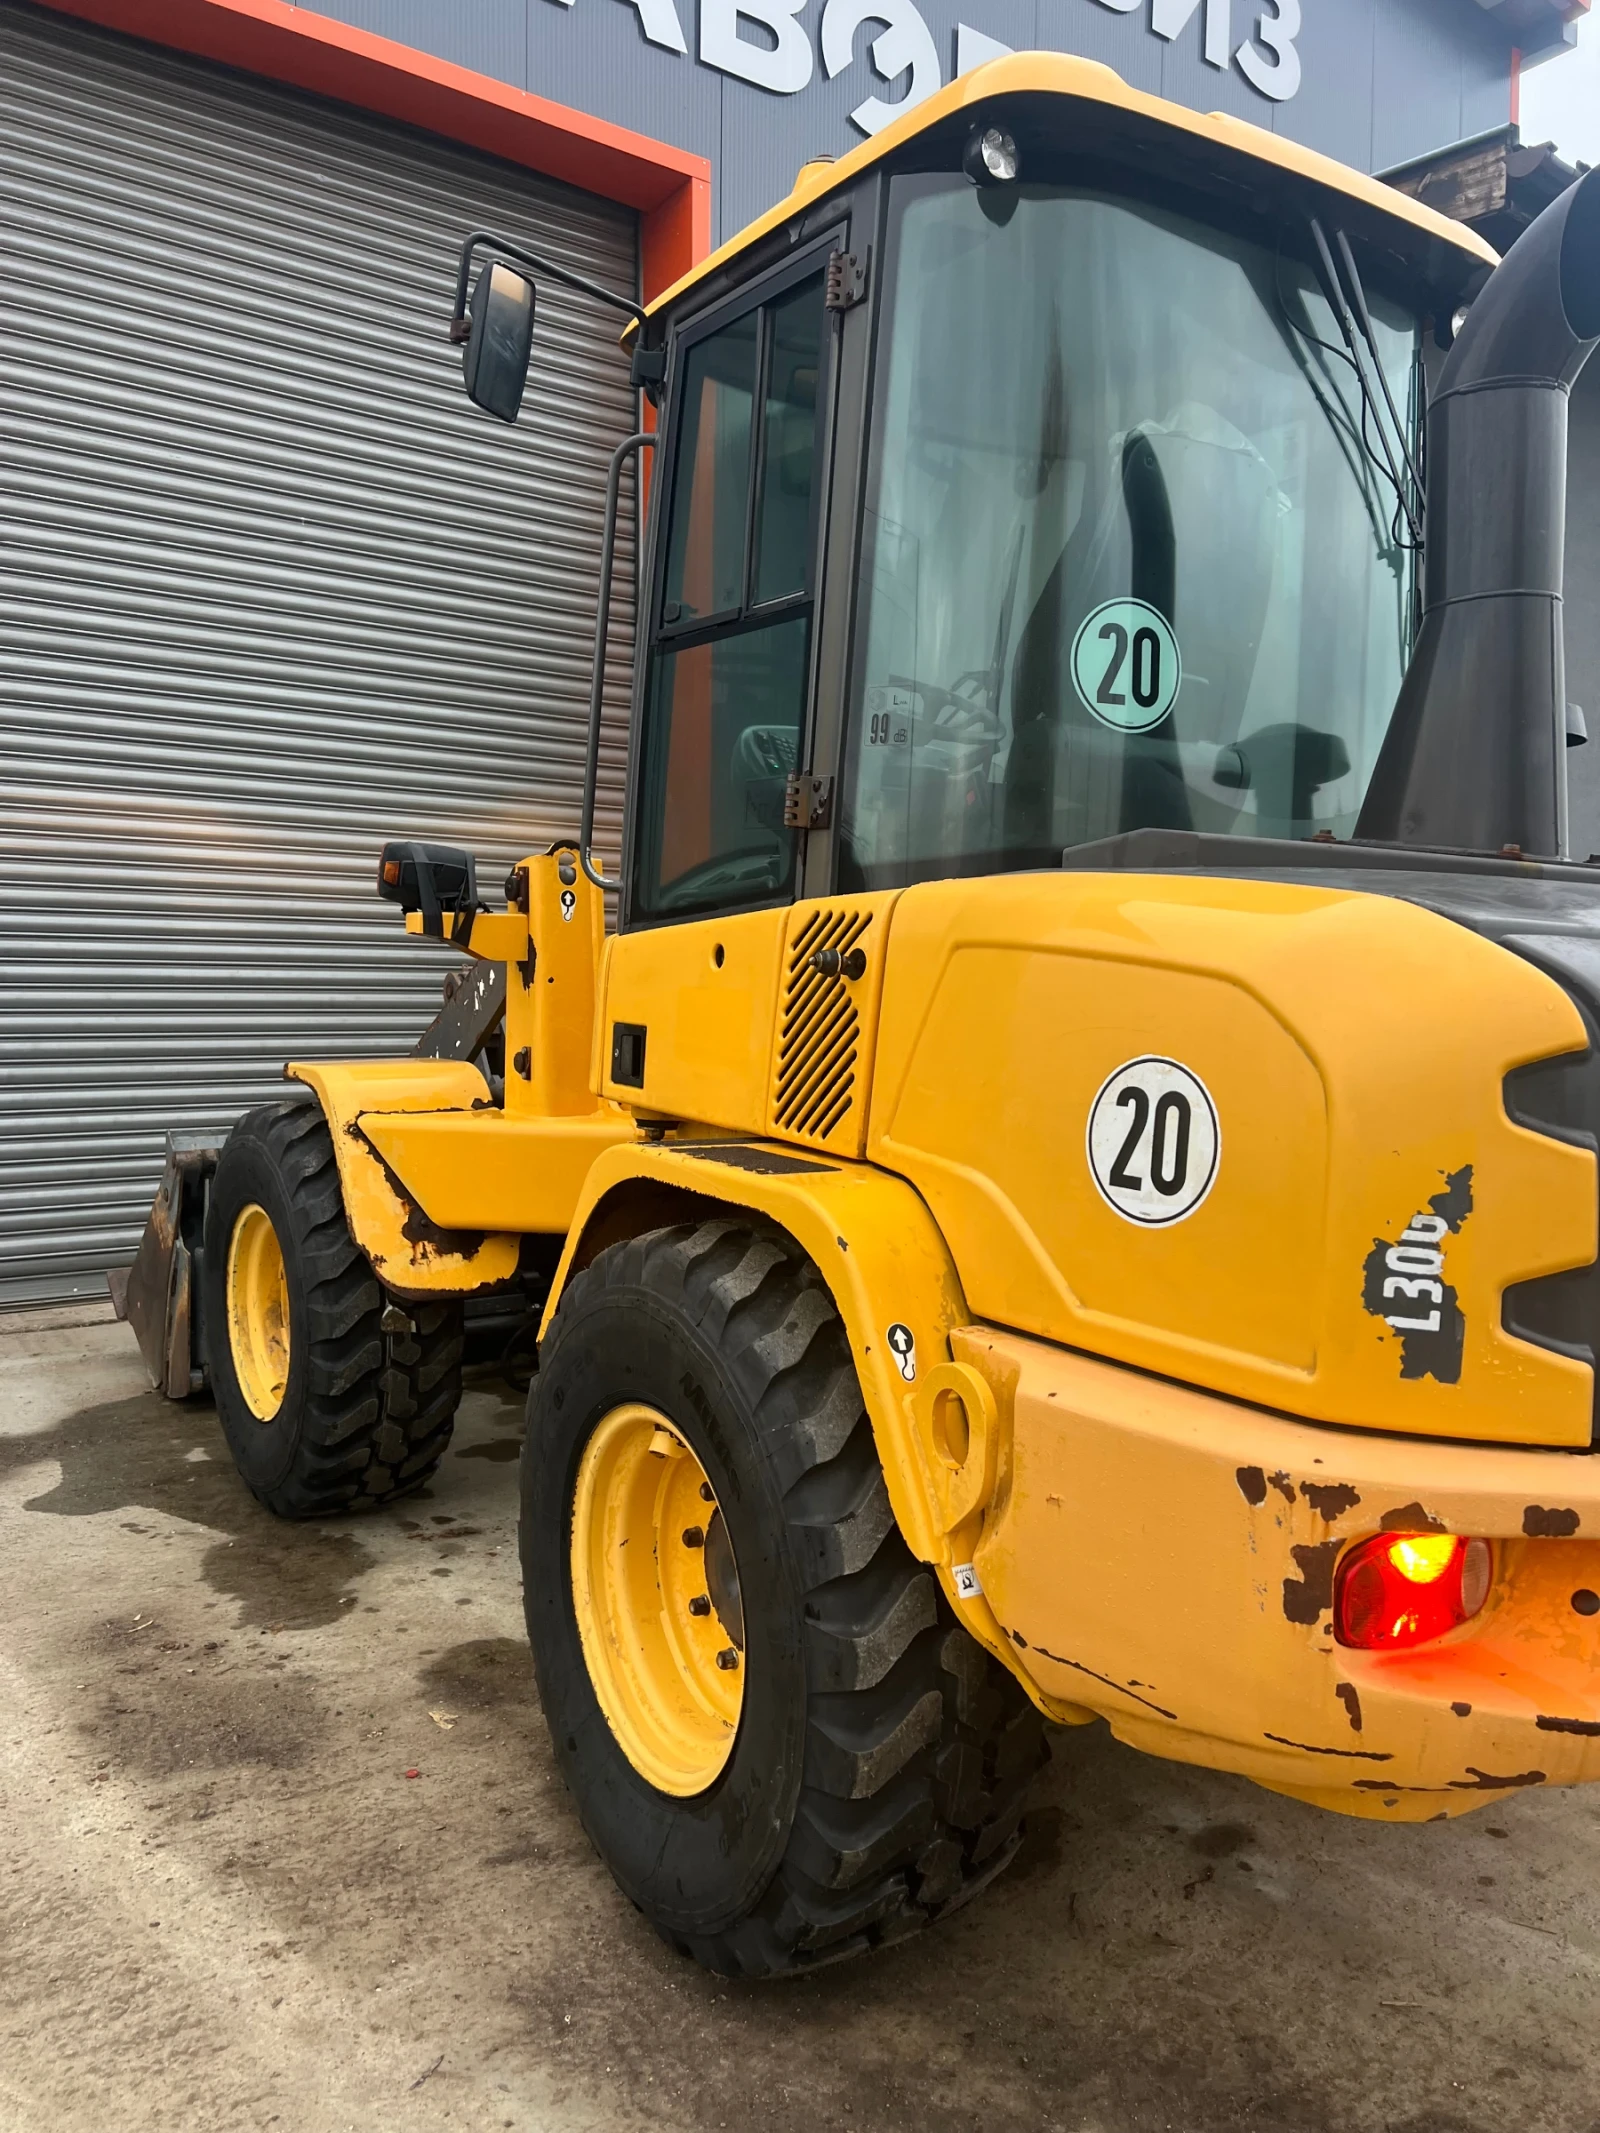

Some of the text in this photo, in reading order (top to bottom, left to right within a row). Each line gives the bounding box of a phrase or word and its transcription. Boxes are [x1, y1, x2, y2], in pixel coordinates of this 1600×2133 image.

[1096, 622, 1161, 708] 20
[870, 713, 907, 745] 99 dB
[1109, 1086, 1192, 1196] 20
